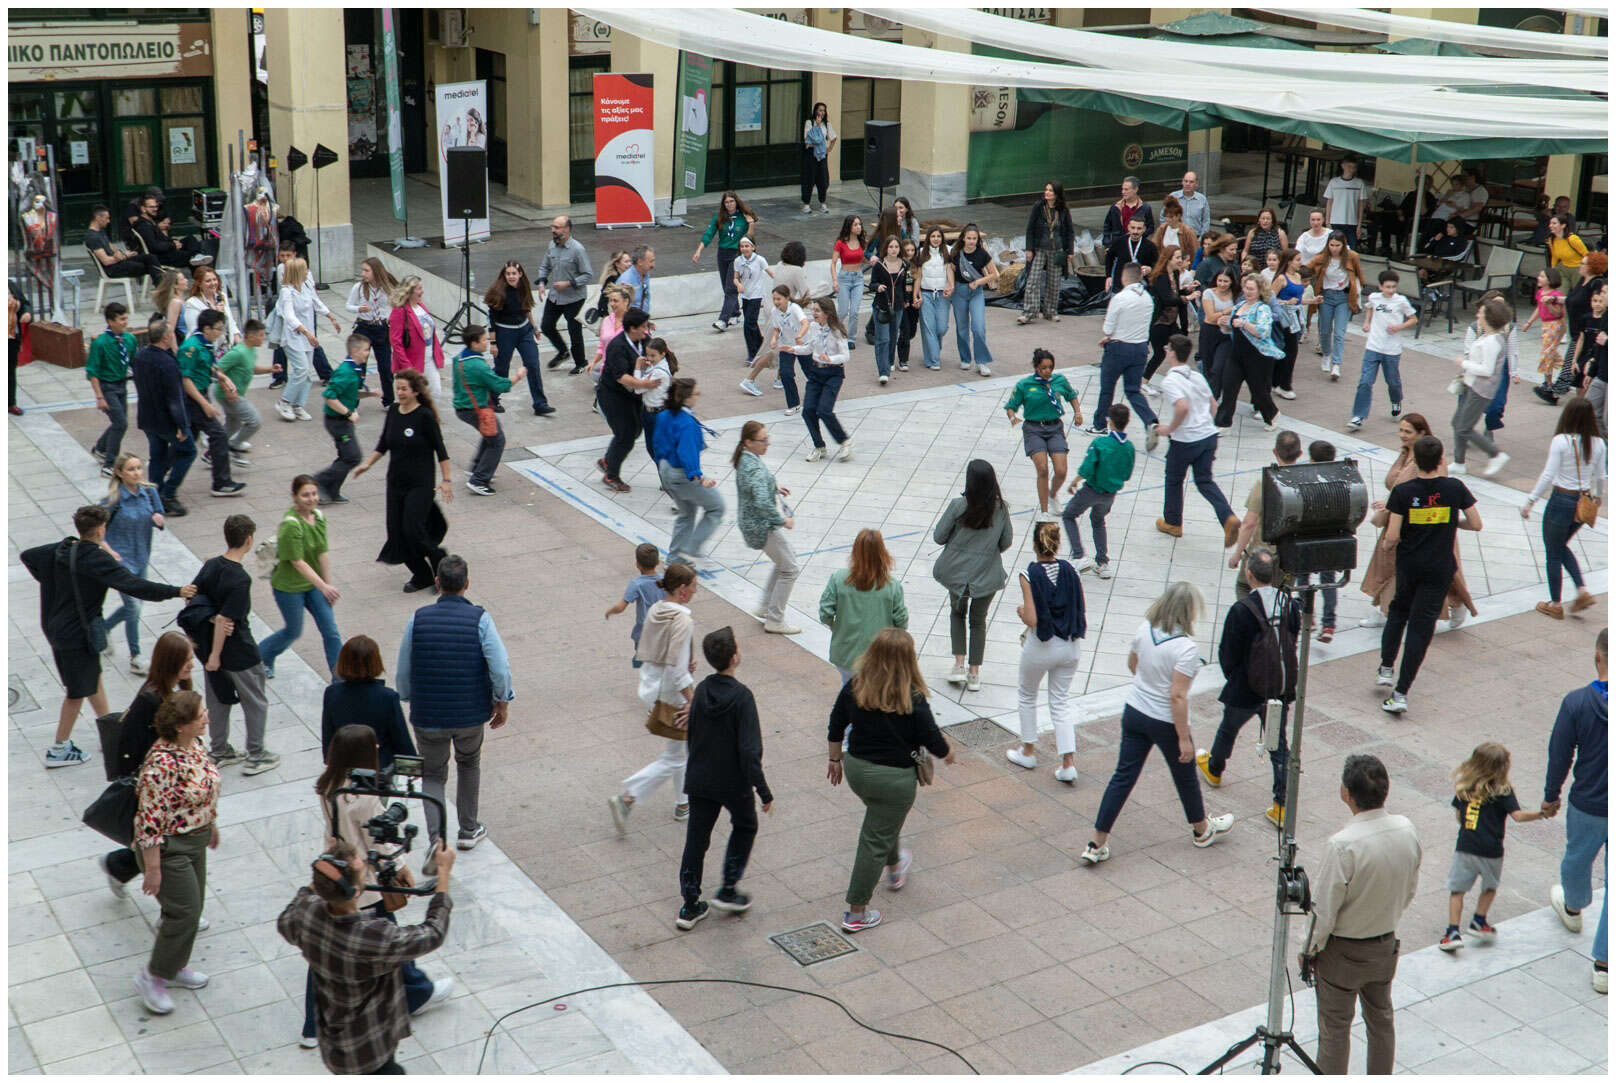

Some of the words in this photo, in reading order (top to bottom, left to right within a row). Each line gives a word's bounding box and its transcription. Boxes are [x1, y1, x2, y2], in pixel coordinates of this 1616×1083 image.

[50, 41, 175, 62] ΠΑΝΤΟΠΩΛΕΙΟ
[444, 88, 479, 100] mediatel
[1149, 146, 1184, 161] JAMESON
